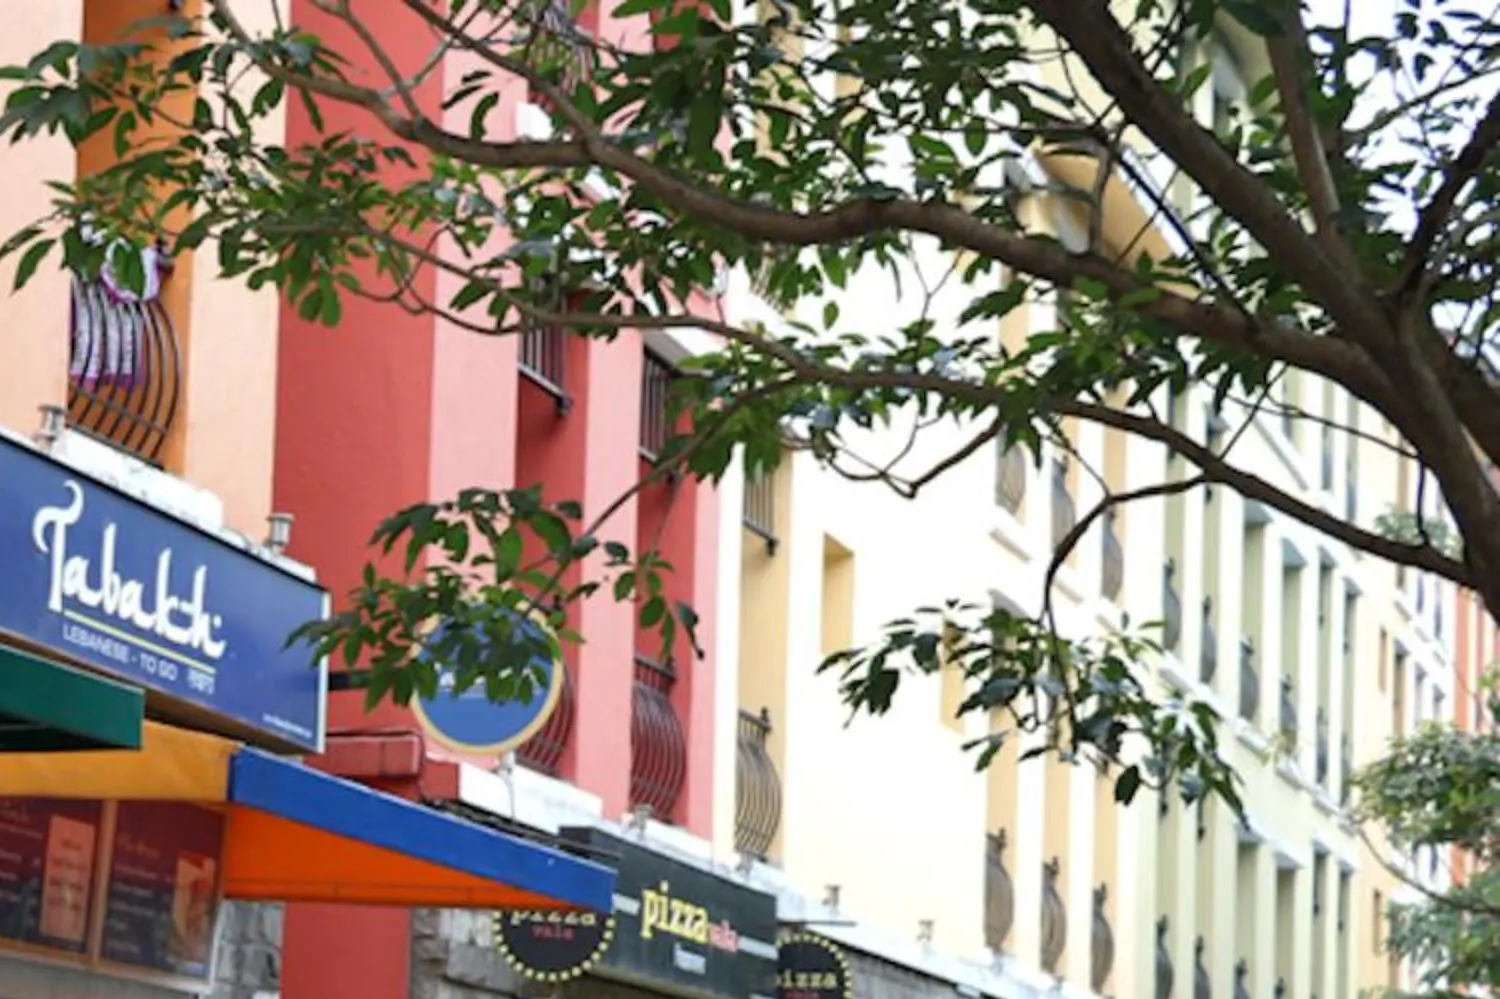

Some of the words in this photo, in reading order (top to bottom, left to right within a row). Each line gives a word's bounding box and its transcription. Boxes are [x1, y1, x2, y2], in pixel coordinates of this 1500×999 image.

[63, 623, 130, 664] LEBANESE
[140, 652, 156, 675] TO
[159, 660, 178, 682] GO
[641, 880, 708, 944] pizza
[776, 969, 837, 989] izza
